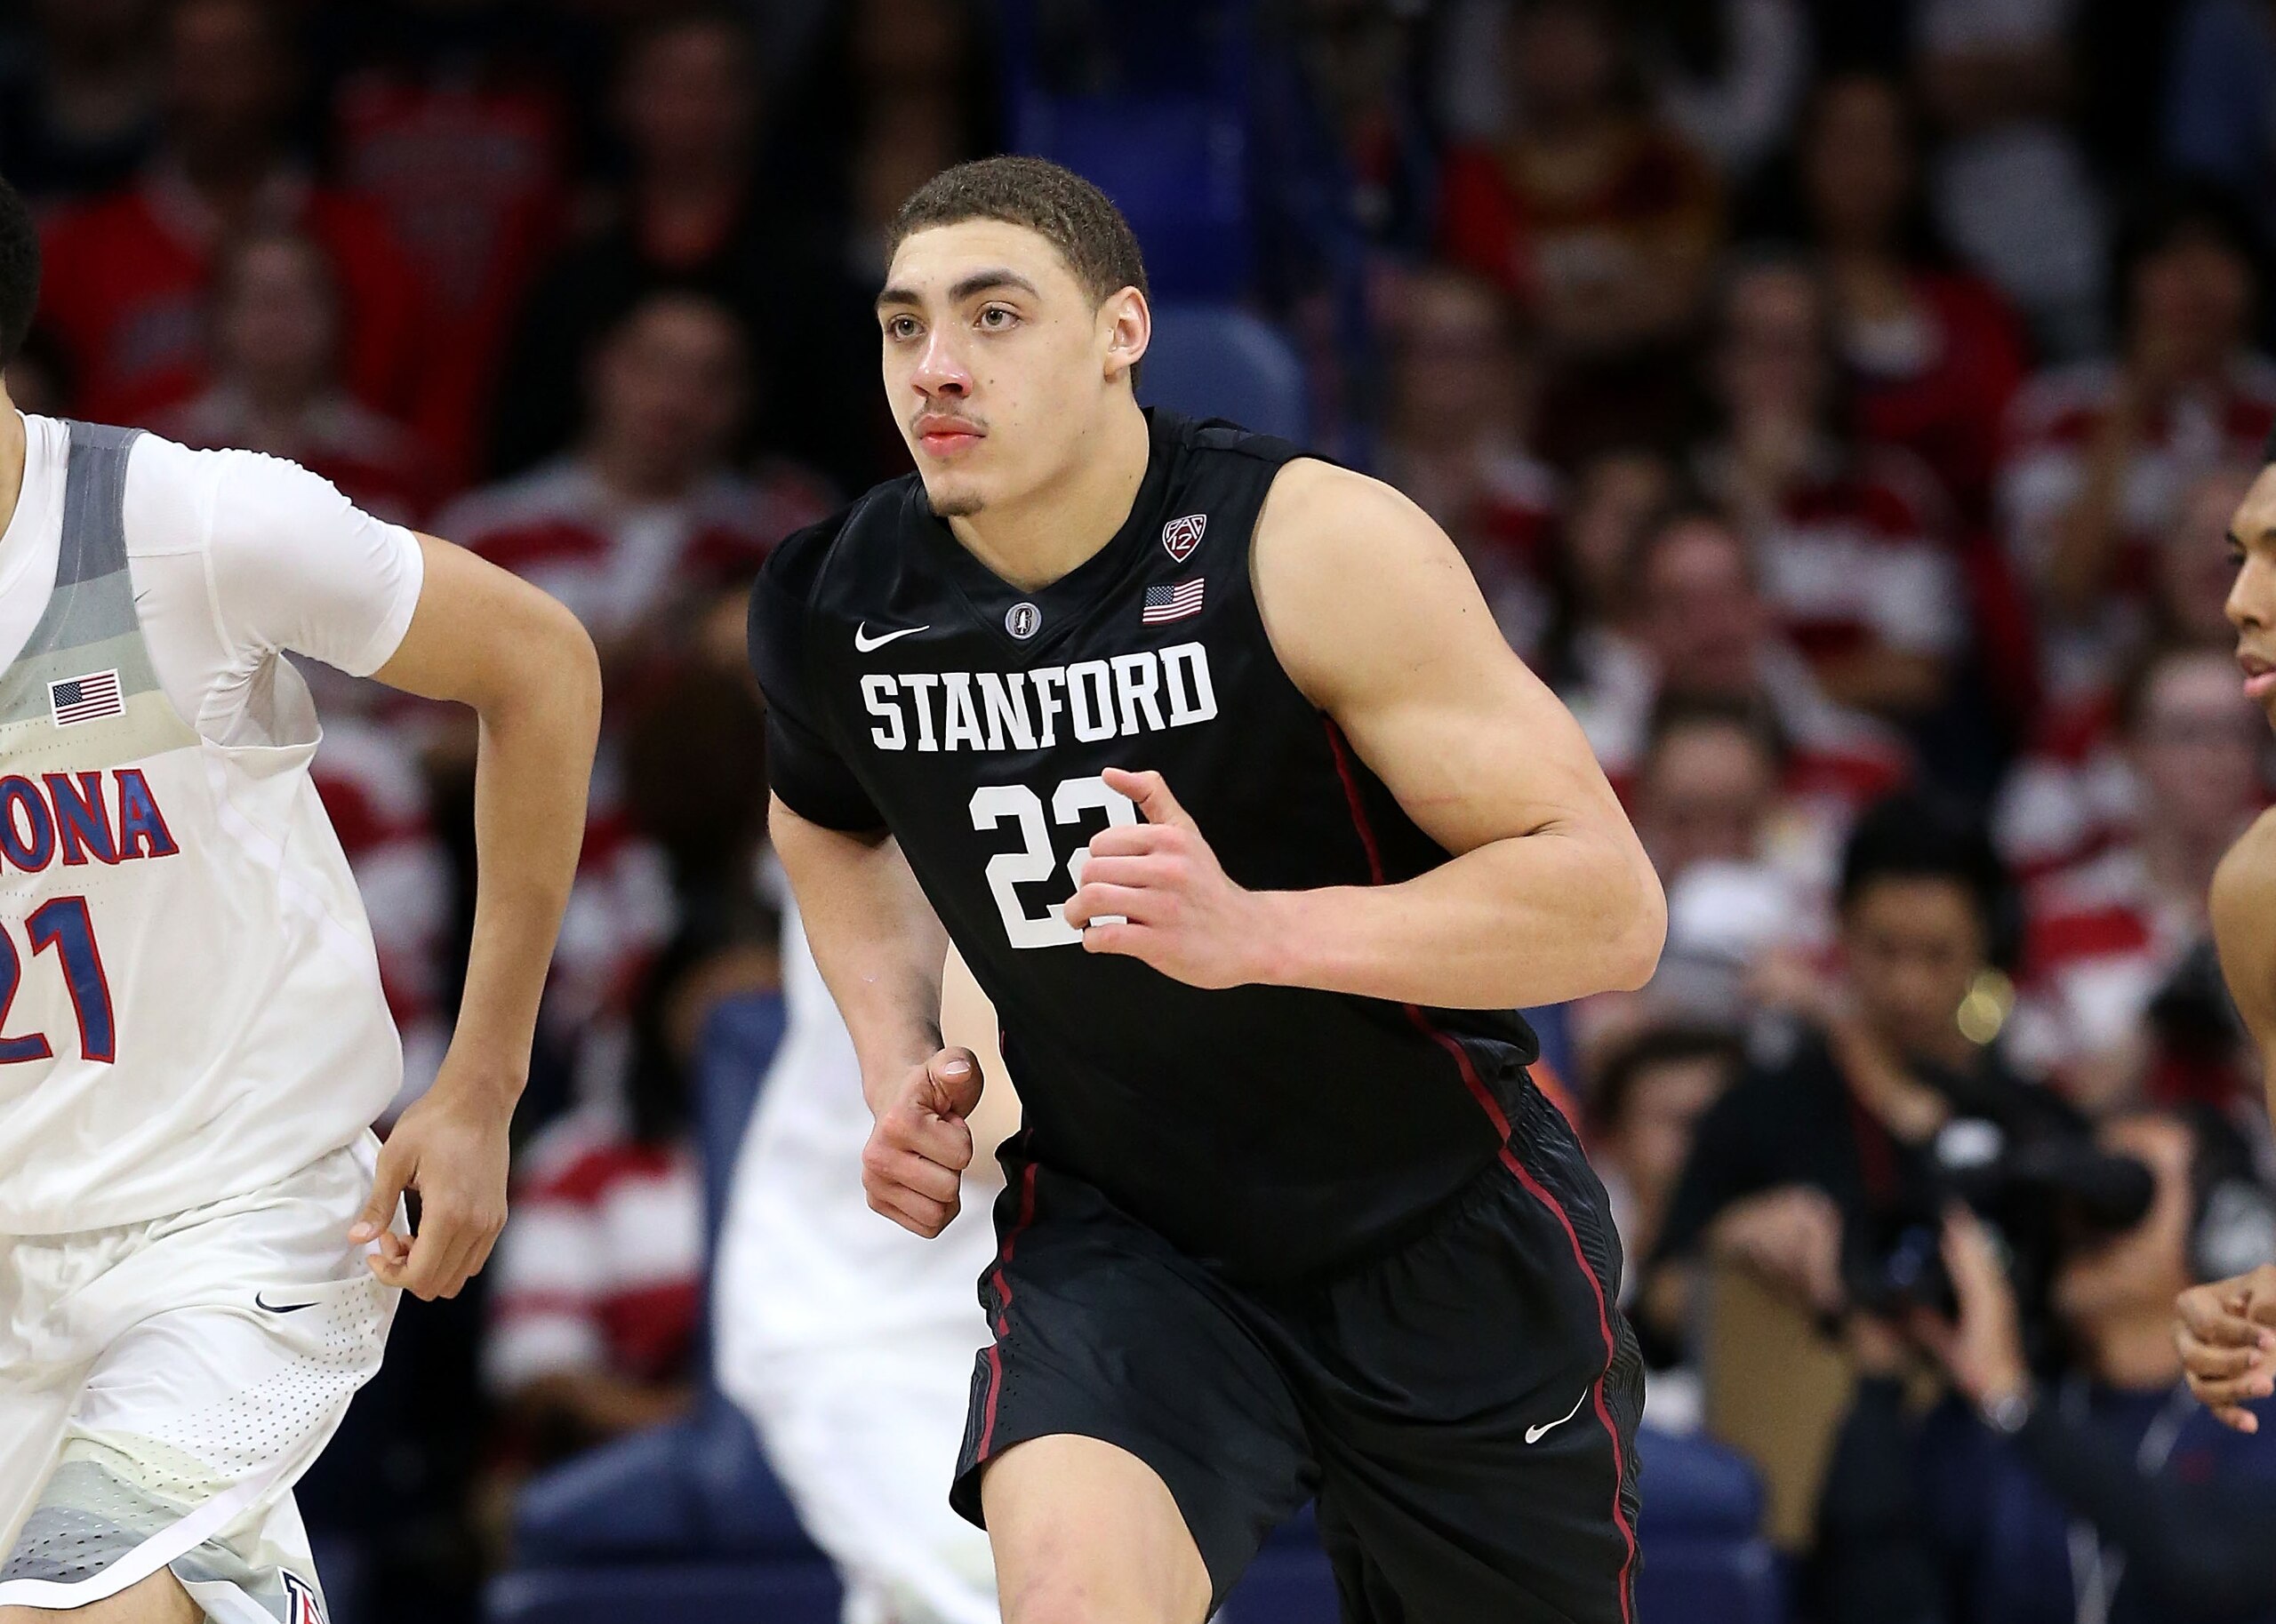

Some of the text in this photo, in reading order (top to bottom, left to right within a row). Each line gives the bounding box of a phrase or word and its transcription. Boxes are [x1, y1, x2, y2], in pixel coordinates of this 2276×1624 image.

[1166, 516, 1205, 540] PAC
[1170, 532, 1193, 550] 12
[860, 641, 1218, 752] STANFORD
